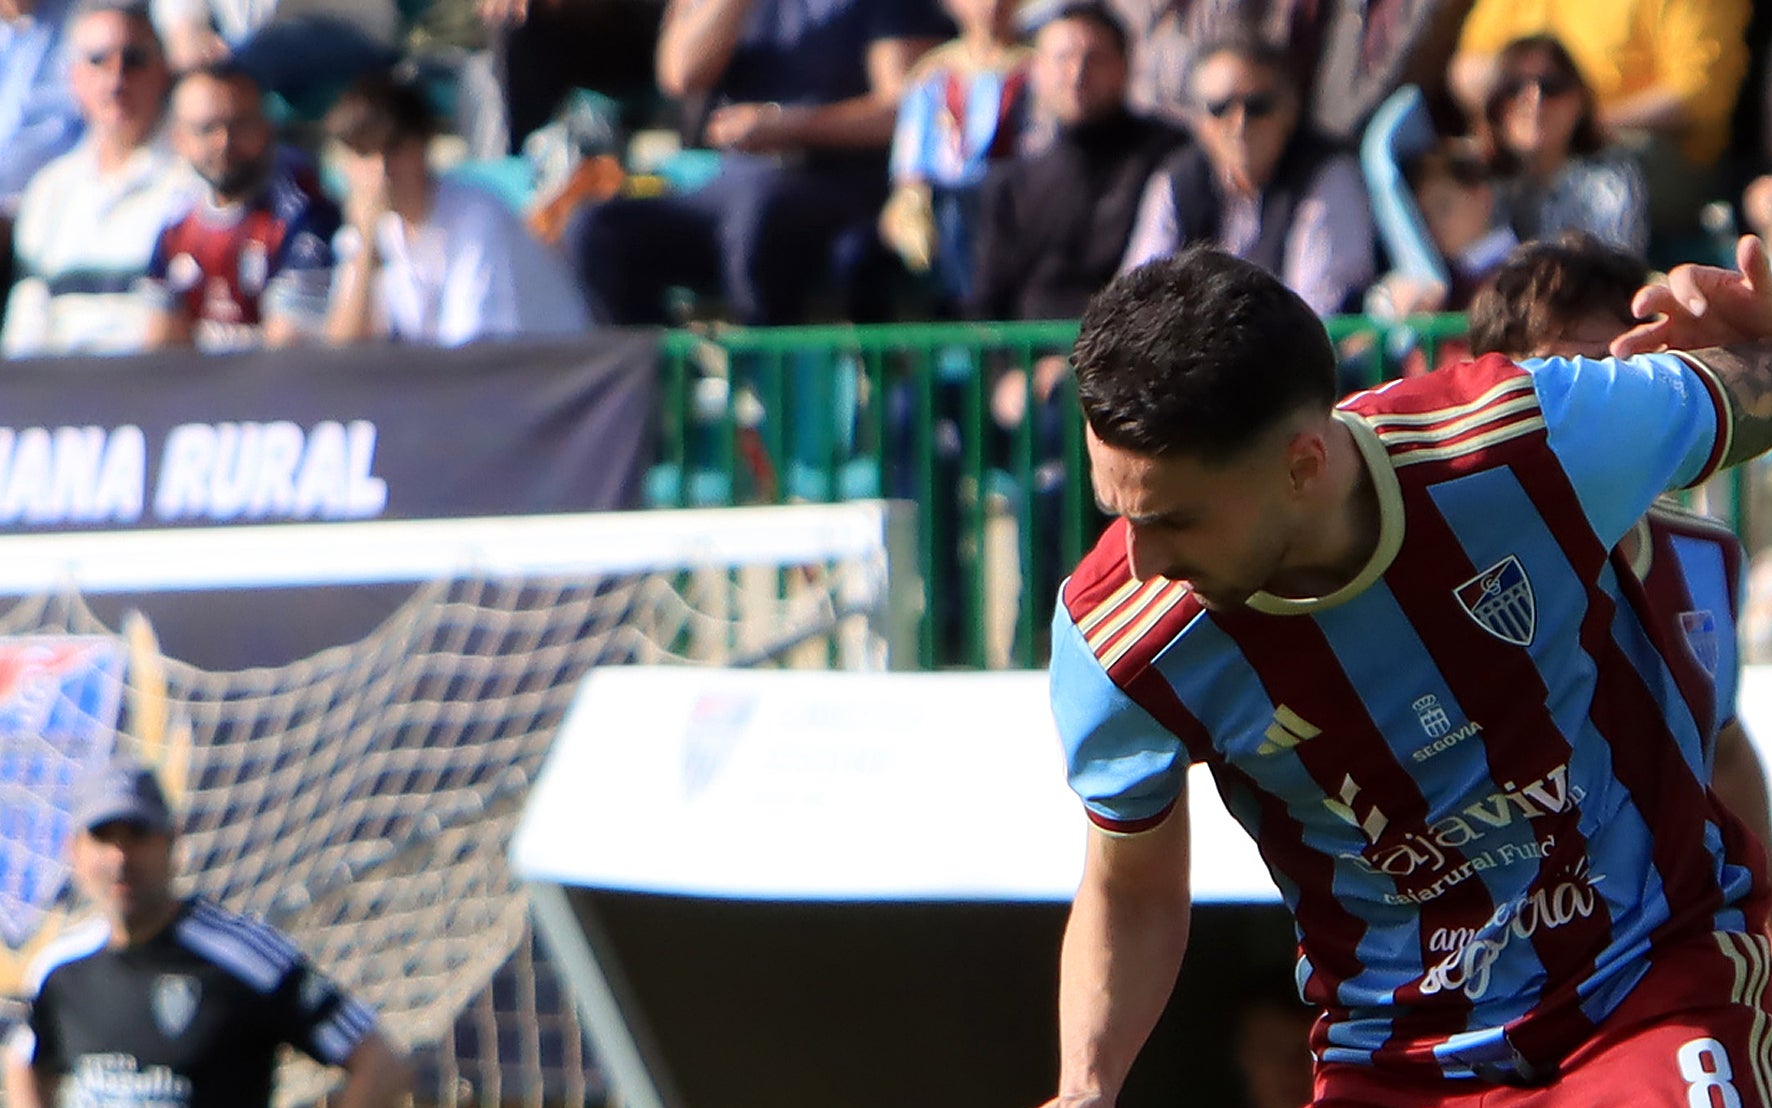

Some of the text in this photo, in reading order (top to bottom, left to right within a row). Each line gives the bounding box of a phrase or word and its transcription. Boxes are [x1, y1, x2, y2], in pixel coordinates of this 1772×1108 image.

[0, 419, 389, 524] ANA RURAL
[1412, 721, 1484, 761] SEGOVIA
